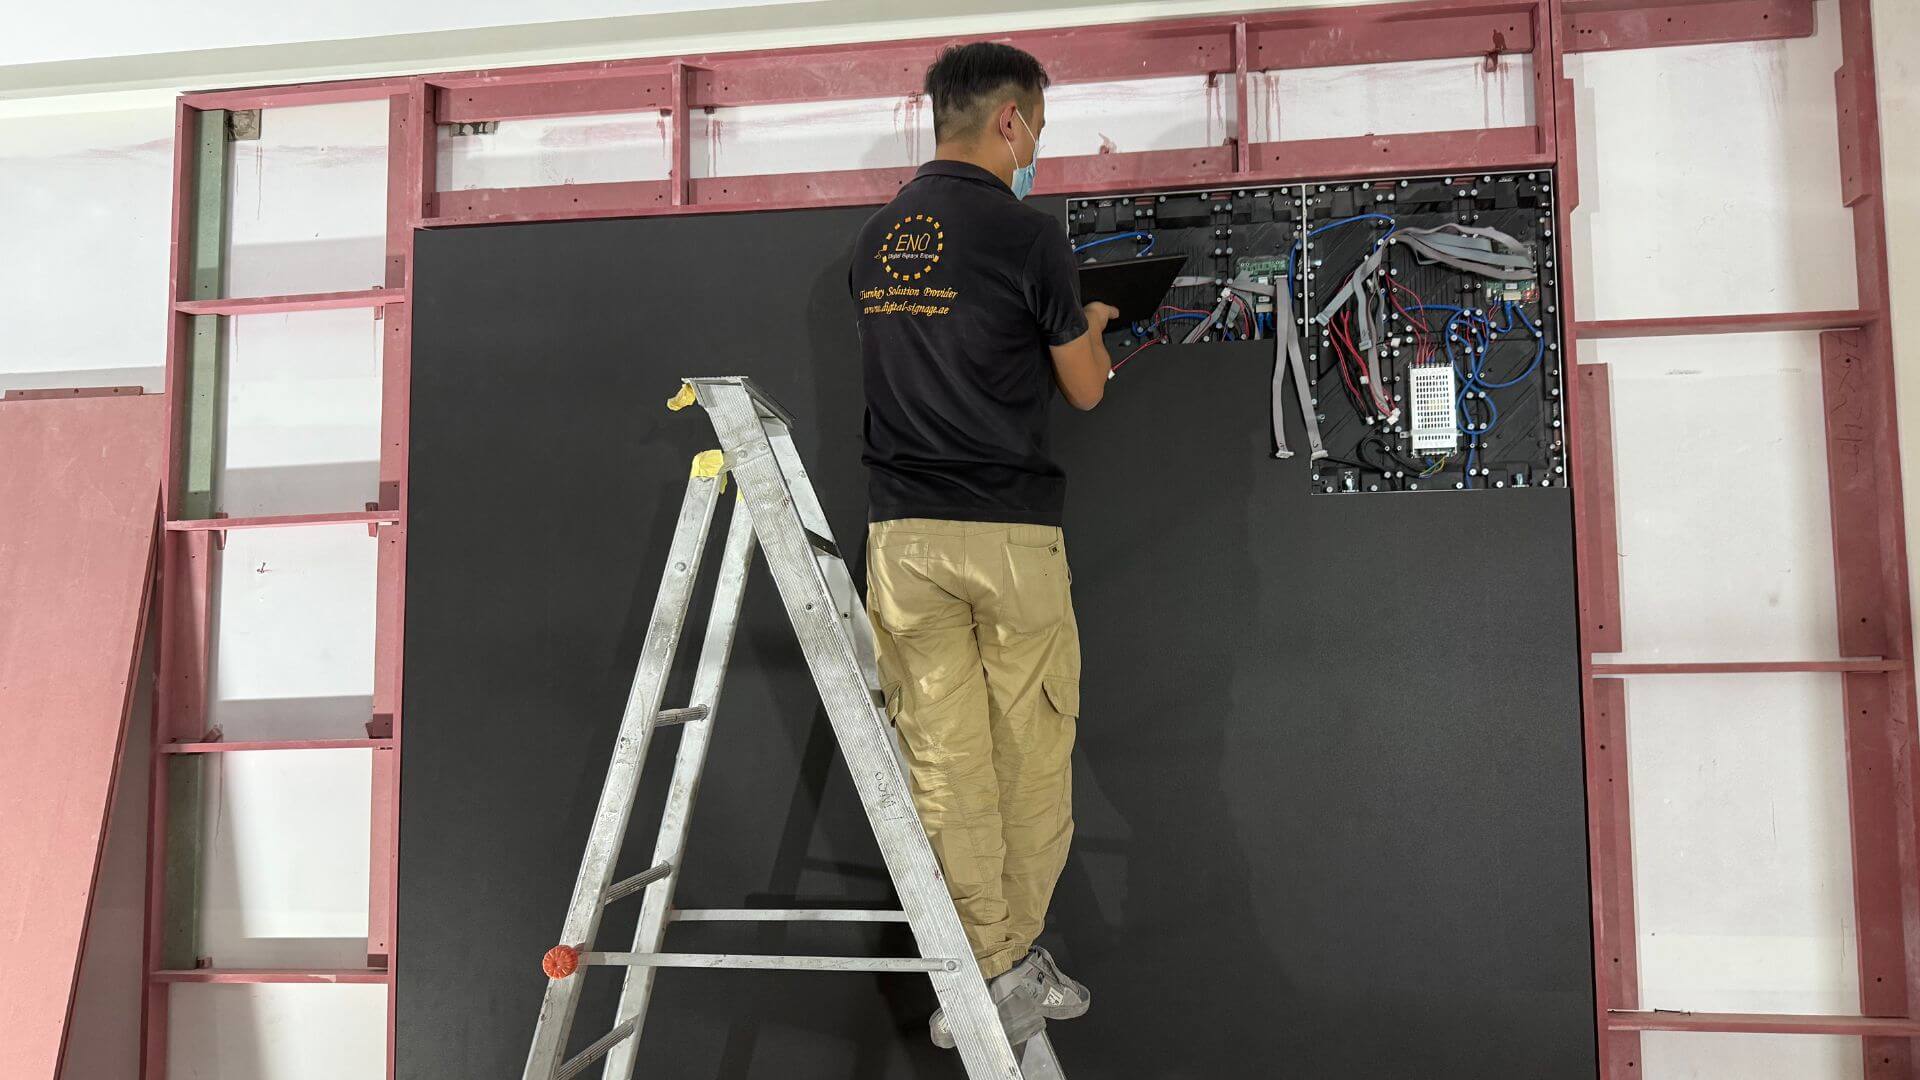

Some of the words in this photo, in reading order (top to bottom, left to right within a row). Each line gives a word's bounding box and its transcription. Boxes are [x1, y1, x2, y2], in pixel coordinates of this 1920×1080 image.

[895, 233, 931, 252] ENO
[860, 287, 884, 300] Turnkey
[887, 285, 920, 297] Solution
[923, 286, 958, 300] Provider
[864, 301, 950, 317] www.digital-signage.ae
